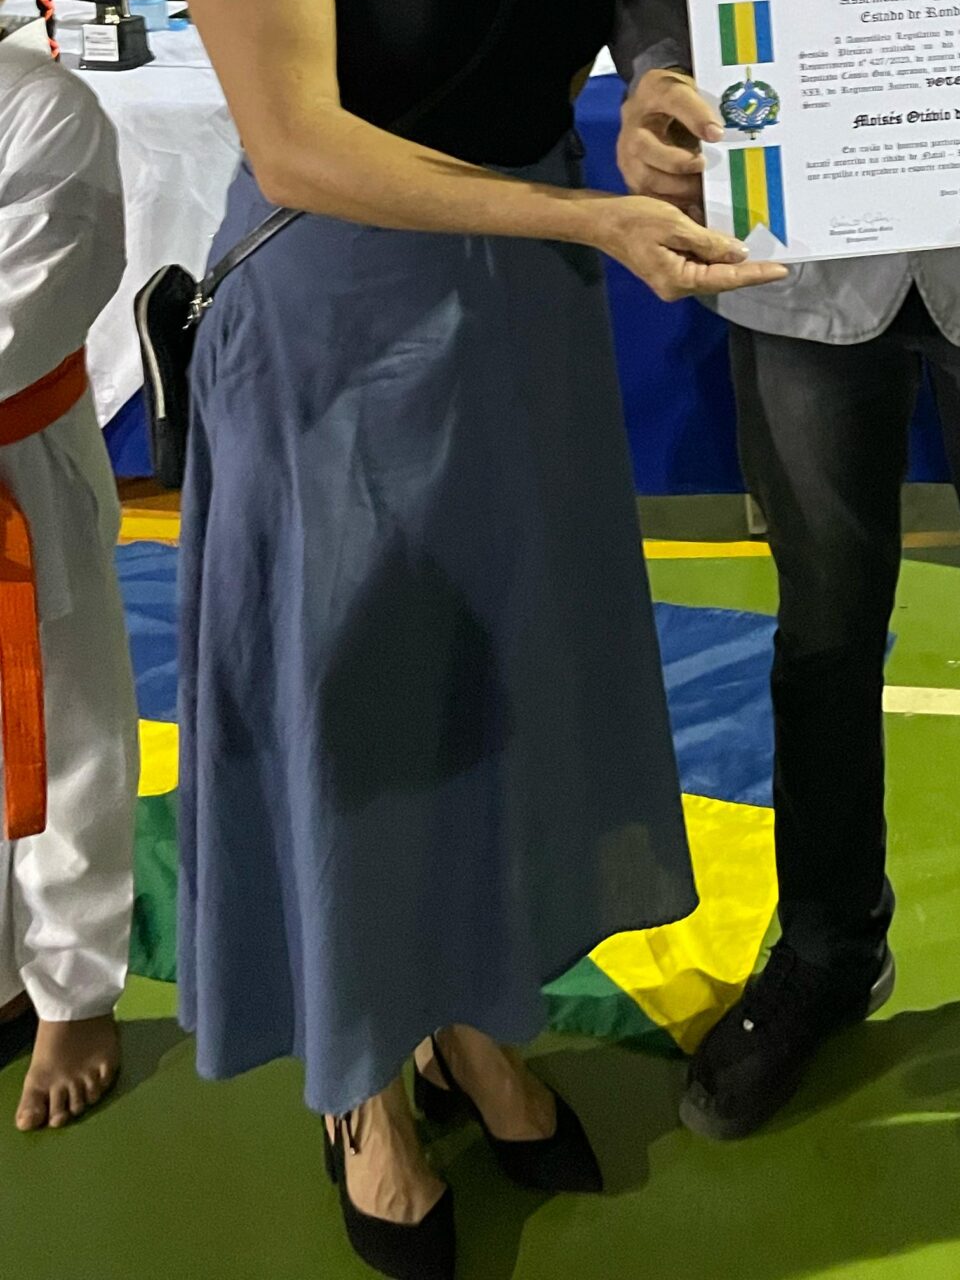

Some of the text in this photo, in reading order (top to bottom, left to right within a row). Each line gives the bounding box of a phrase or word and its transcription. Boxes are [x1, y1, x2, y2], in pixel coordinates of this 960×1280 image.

[861, 11, 904, 23] Estado
[907, 10, 922, 19] de
[853, 111, 903, 128] Moisés
[907, 109, 951, 123] Otávio
